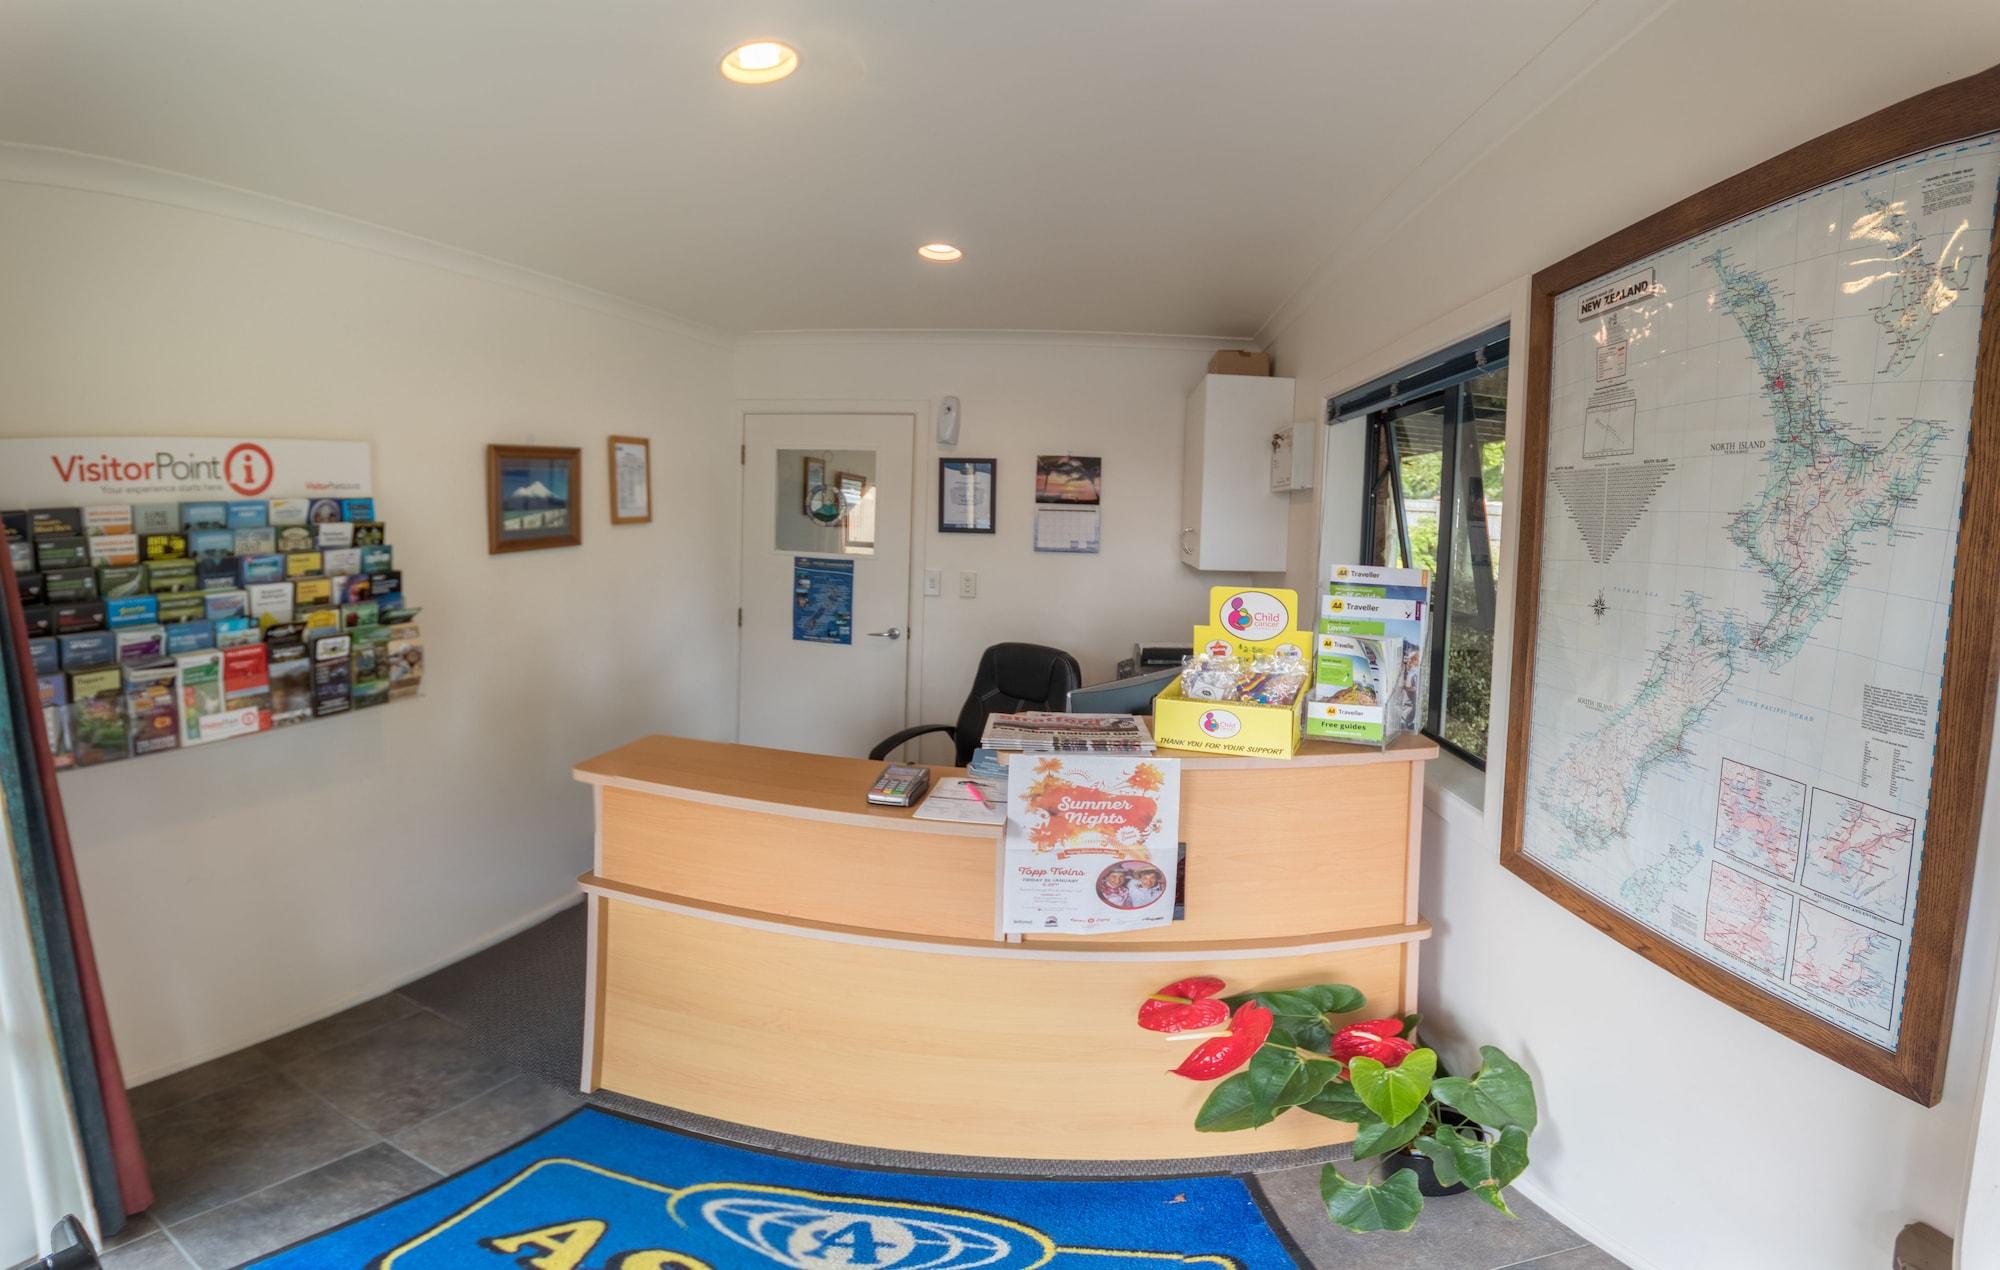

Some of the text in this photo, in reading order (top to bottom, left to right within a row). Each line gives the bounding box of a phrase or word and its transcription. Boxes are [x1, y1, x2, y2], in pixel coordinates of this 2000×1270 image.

[1581, 298, 1602, 314] NEW
[1604, 281, 1649, 304] ZEALAND
[1710, 440, 1766, 451] NORTH ISLAND
[51, 452, 221, 482] VisitorPoint
[1351, 570, 1380, 578] Traveller
[1347, 602, 1380, 612] Traveller
[1254, 612, 1280, 622] Child
[1339, 708, 1364, 716] Traveller
[1340, 722, 1367, 730] guides
[1159, 737, 1185, 745] THANK
[1223, 744, 1245, 752] YOUR
[1246, 746, 1284, 755] SUPPORT
[1058, 796, 1133, 811] Summer
[1065, 811, 1127, 829] Nights
[1018, 867, 1086, 877] Topp Twins
